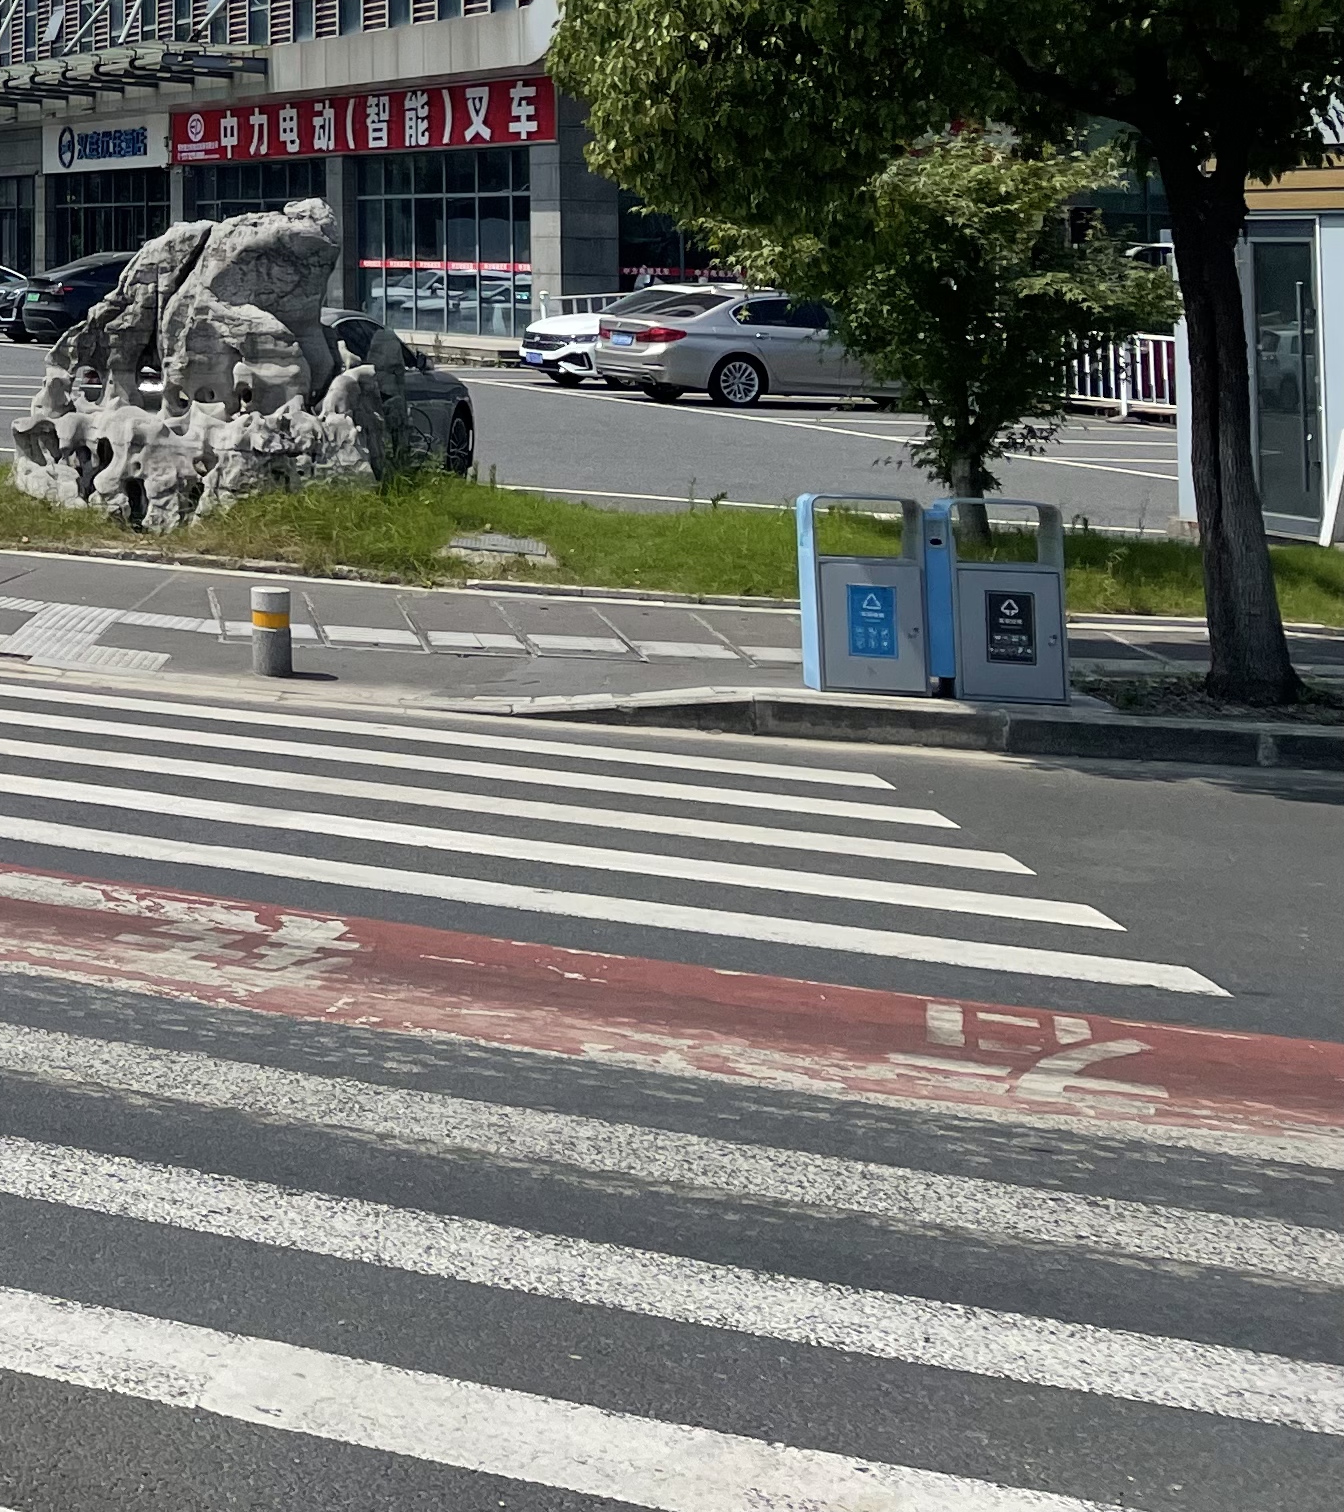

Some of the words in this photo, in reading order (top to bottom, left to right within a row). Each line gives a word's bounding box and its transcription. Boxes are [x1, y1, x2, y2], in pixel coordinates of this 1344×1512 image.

[220, 81, 539, 159] 中力电动(智能)叉车
